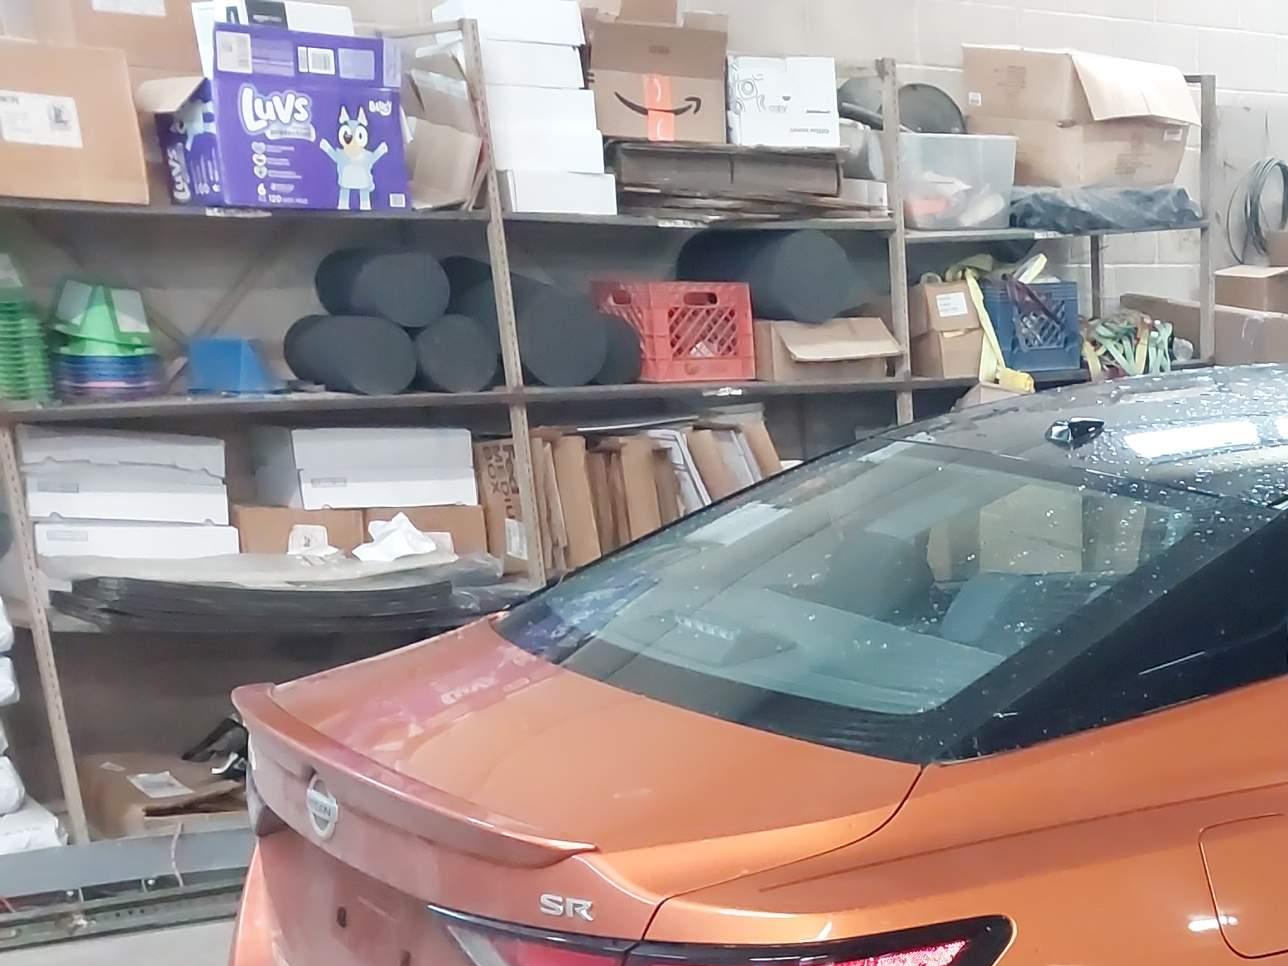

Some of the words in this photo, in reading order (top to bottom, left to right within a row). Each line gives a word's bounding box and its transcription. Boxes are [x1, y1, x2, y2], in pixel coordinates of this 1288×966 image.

[240, 86, 310, 132] Luvs
[167, 147, 192, 200] Luvs
[540, 893, 595, 922] SR
